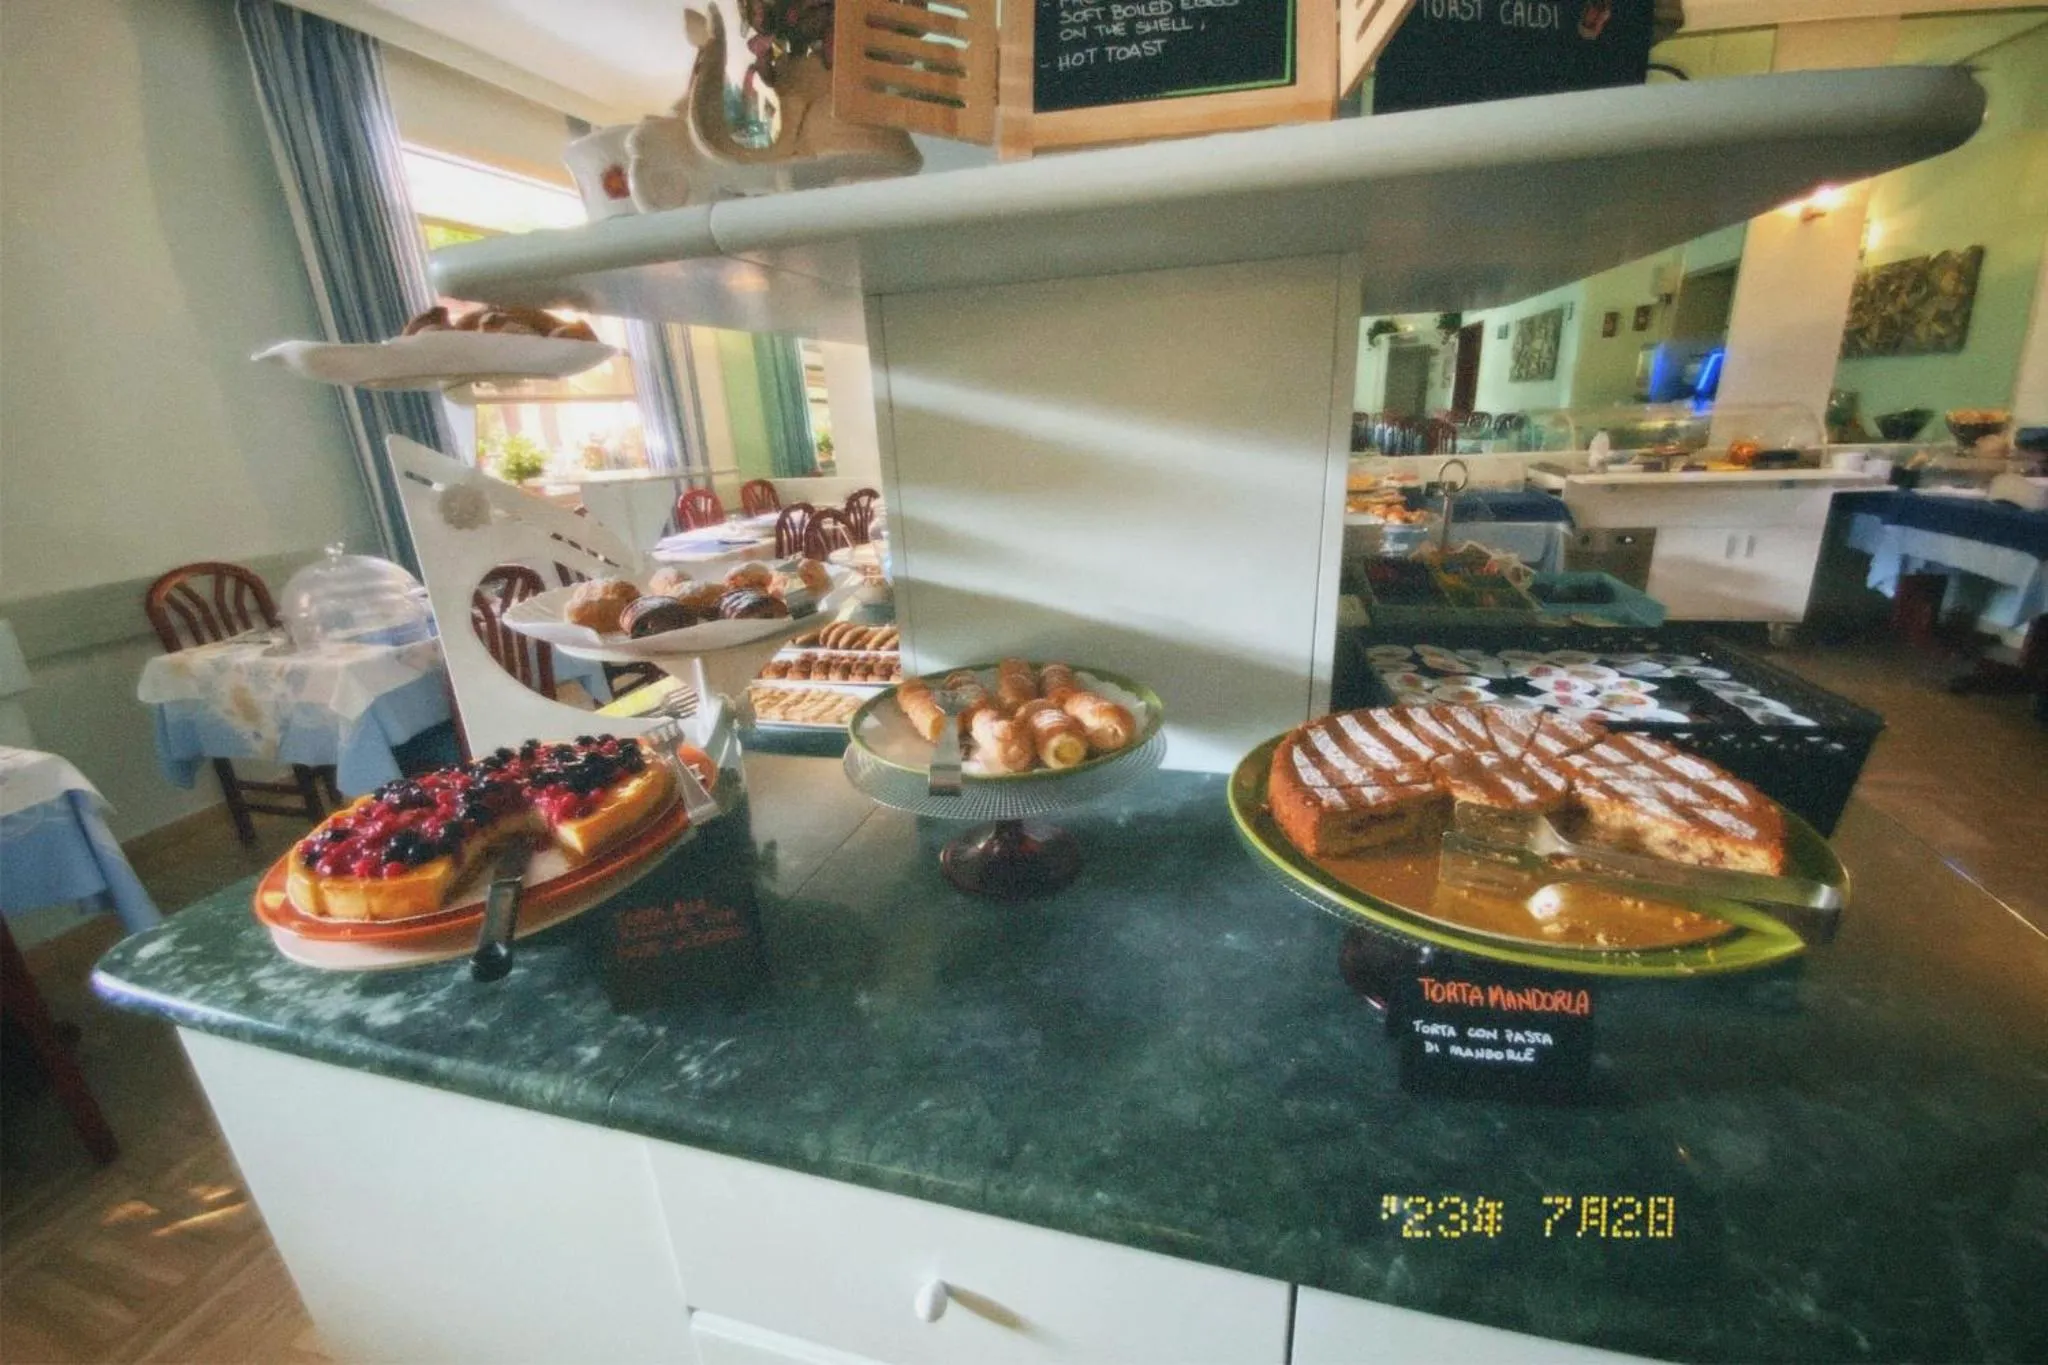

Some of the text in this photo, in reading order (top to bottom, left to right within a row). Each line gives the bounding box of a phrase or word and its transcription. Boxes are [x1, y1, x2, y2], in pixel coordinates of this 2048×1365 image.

[1059, 8, 1106, 25] SOFT
[1111, 0, 1174, 20] BOILED
[1422, 0, 1560, 29] TOAST CALDI
[1060, 26, 1087, 41] ON
[1058, 39, 1168, 71] HOT TOAST
[1417, 977, 1590, 1015] TORTA MANDORLA
[1412, 1019, 1554, 1046] TORTA CON PASTA
